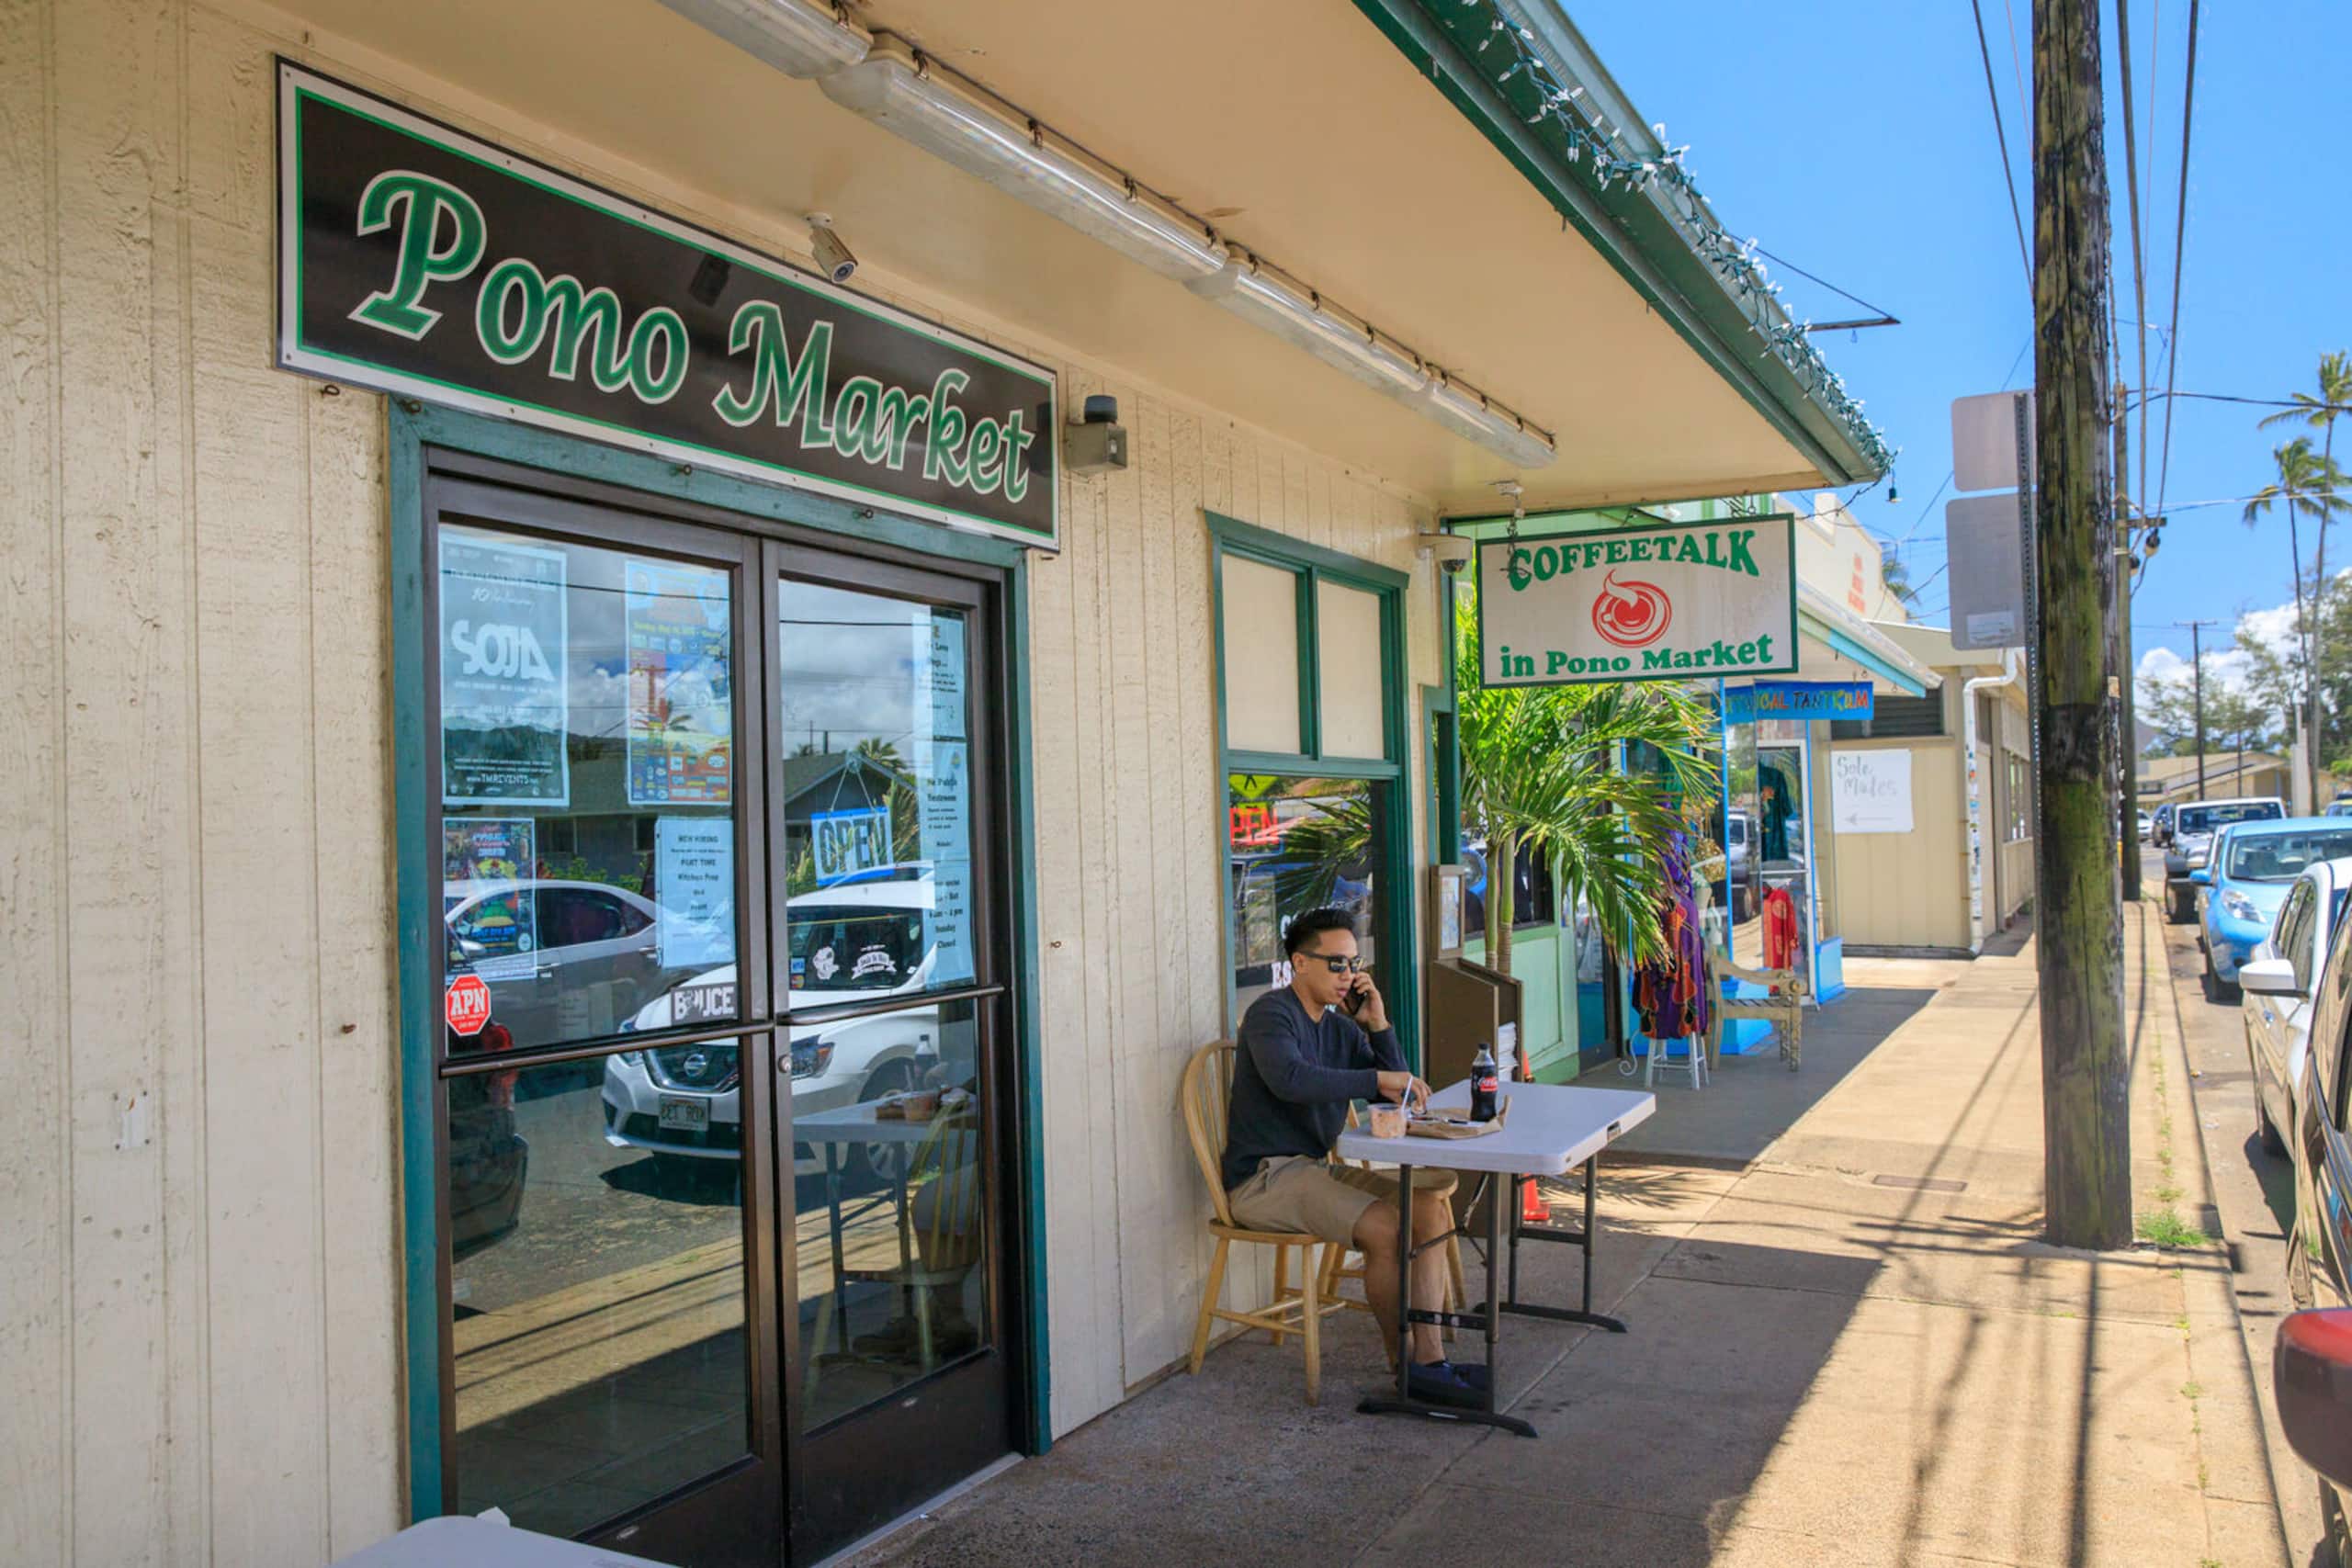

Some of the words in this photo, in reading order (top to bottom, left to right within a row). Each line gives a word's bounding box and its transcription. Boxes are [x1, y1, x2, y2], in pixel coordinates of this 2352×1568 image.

[347, 170, 689, 404] Pono
[712, 300, 1035, 503] Market
[1508, 530, 1760, 592] COFFEETALK
[451, 619, 555, 682] SOJA
[1500, 646, 1535, 678] in
[1545, 650, 1631, 675] Pono
[1642, 633, 1773, 670] Market
[1793, 690, 1869, 712] TANTRUM
[1838, 756, 1873, 779] Sole
[819, 816, 887, 874] OPEN
[1229, 807, 1279, 846] PEN
[450, 987, 485, 1016] APN
